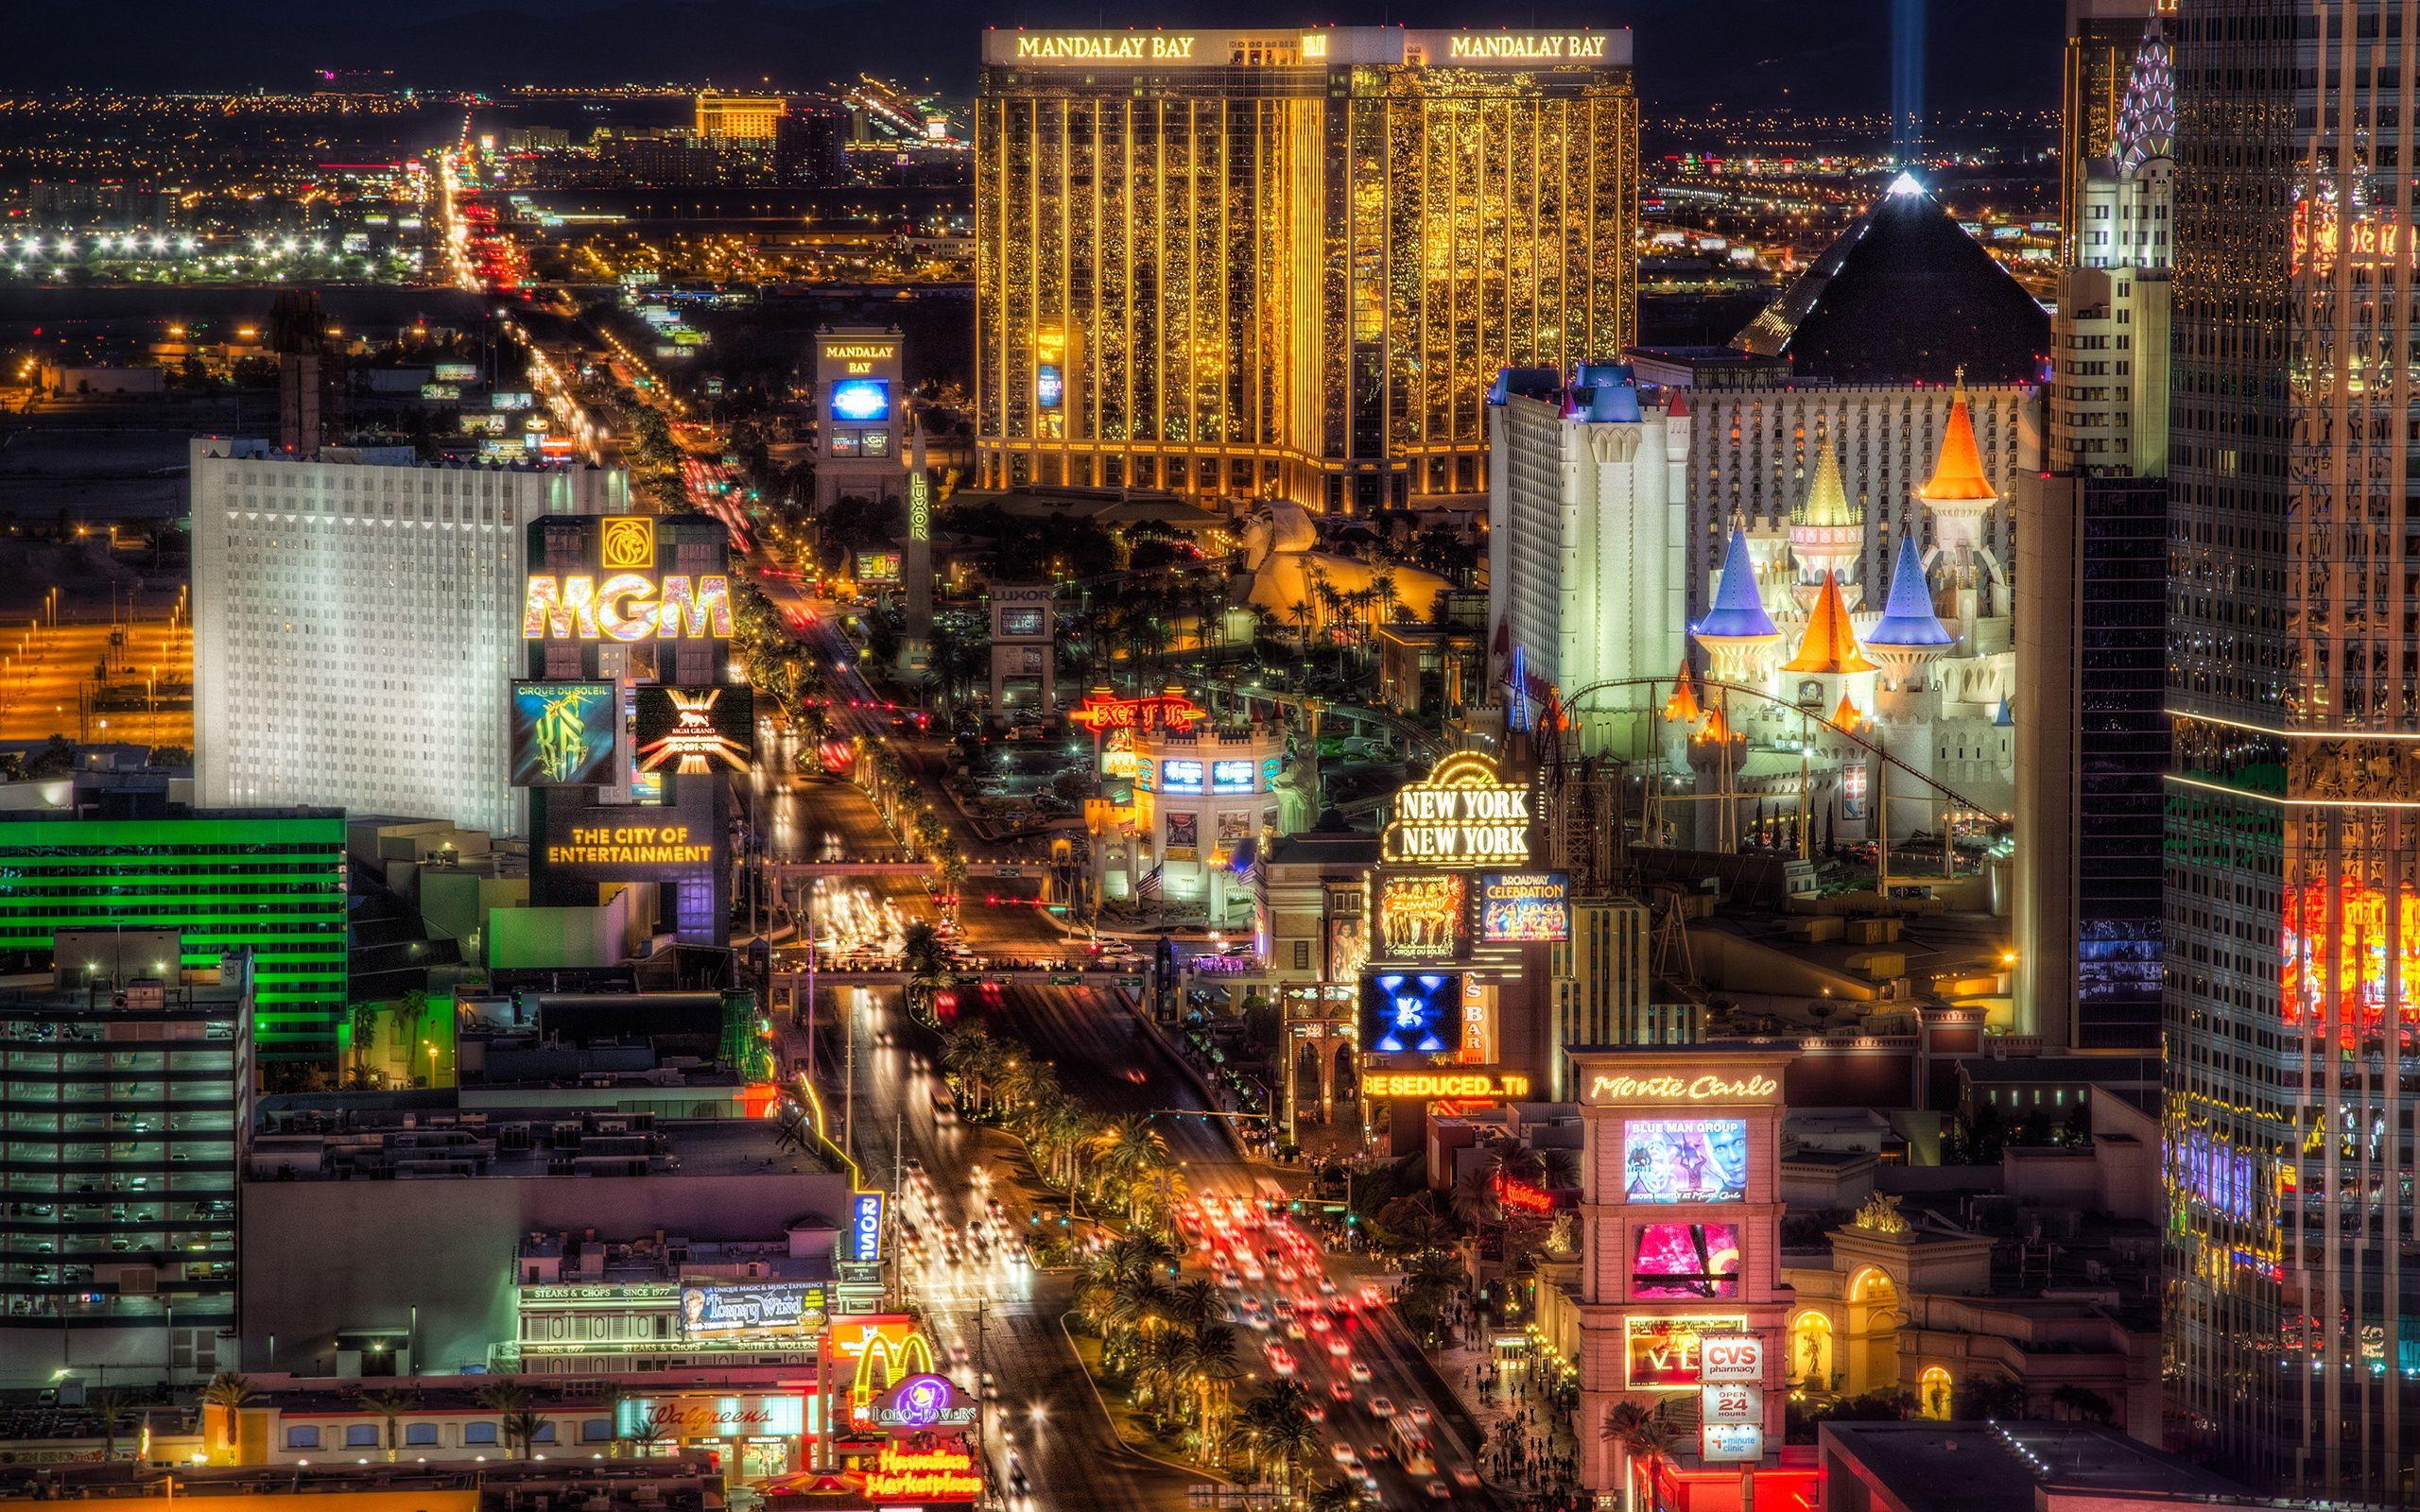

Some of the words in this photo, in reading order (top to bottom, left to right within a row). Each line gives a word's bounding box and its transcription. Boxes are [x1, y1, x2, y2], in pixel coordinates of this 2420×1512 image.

[1018, 37, 1144, 57] MANDALAY
[1151, 37, 1194, 57] BAY
[1451, 36, 1564, 57] MANDALAY
[1568, 36, 1606, 57] BAY
[826, 347, 894, 357] MANDALAY
[848, 362, 872, 373] BAY
[913, 473, 929, 541] LUXOR
[992, 590, 1053, 601] LUXOR
[523, 574, 735, 642] MGM
[518, 687, 556, 697] CIRQUE
[558, 687, 573, 696] DU
[1402, 790, 1459, 819] NEW
[1461, 790, 1530, 819] YORK
[572, 828, 610, 845] THE
[614, 828, 657, 845] CITY
[661, 827, 688, 844] OF
[1402, 827, 1459, 855] NEW
[1461, 826, 1530, 855] YORK
[548, 846, 712, 863] ENTERTAINMENT
[1501, 875, 1549, 886] BROADWAY
[1486, 884, 1564, 900] CELEBRATION
[1392, 896, 1449, 910] ZUMANITY
[1463, 1005, 1484, 1049] BAR
[1591, 1074, 1687, 1099] Monte
[1688, 1074, 1777, 1099] Carlo
[1632, 1122, 1665, 1134] BLUE
[1667, 1122, 1695, 1133] MAN
[1696, 1122, 1738, 1134] GROUP
[1691, 1191, 1718, 1201] Monte
[1720, 1191, 1741, 1200] Carlo
[788, 1281, 823, 1290] EXPERIENCE
[534, 1289, 568, 1298] STEAKS
[570, 1289, 578, 1297] &
[581, 1288, 611, 1297] CHOPS
[622, 1288, 648, 1297] SINCE
[652, 1288, 670, 1297] 1977
[537, 1345, 564, 1354] SINCE
[566, 1345, 586, 1354] 1977
[622, 1344, 657, 1353] STEAKS
[660, 1344, 667, 1352] &
[670, 1342, 700, 1352] CHOPS
[737, 1342, 766, 1350] SMITH
[1708, 1346, 1756, 1366] CVS
[1709, 1366, 1755, 1375] pharmacy
[1719, 1399, 1748, 1411] 24
[646, 1403, 773, 1431] Walgreens
[872, 1407, 913, 1421] POLO
[921, 1407, 977, 1421] TOWERS
[1727, 1436, 1755, 1445] minute
[1722, 1444, 1745, 1452] clinic
[878, 1449, 972, 1475] Hawaiian
[864, 1470, 983, 1497] Marketplace
